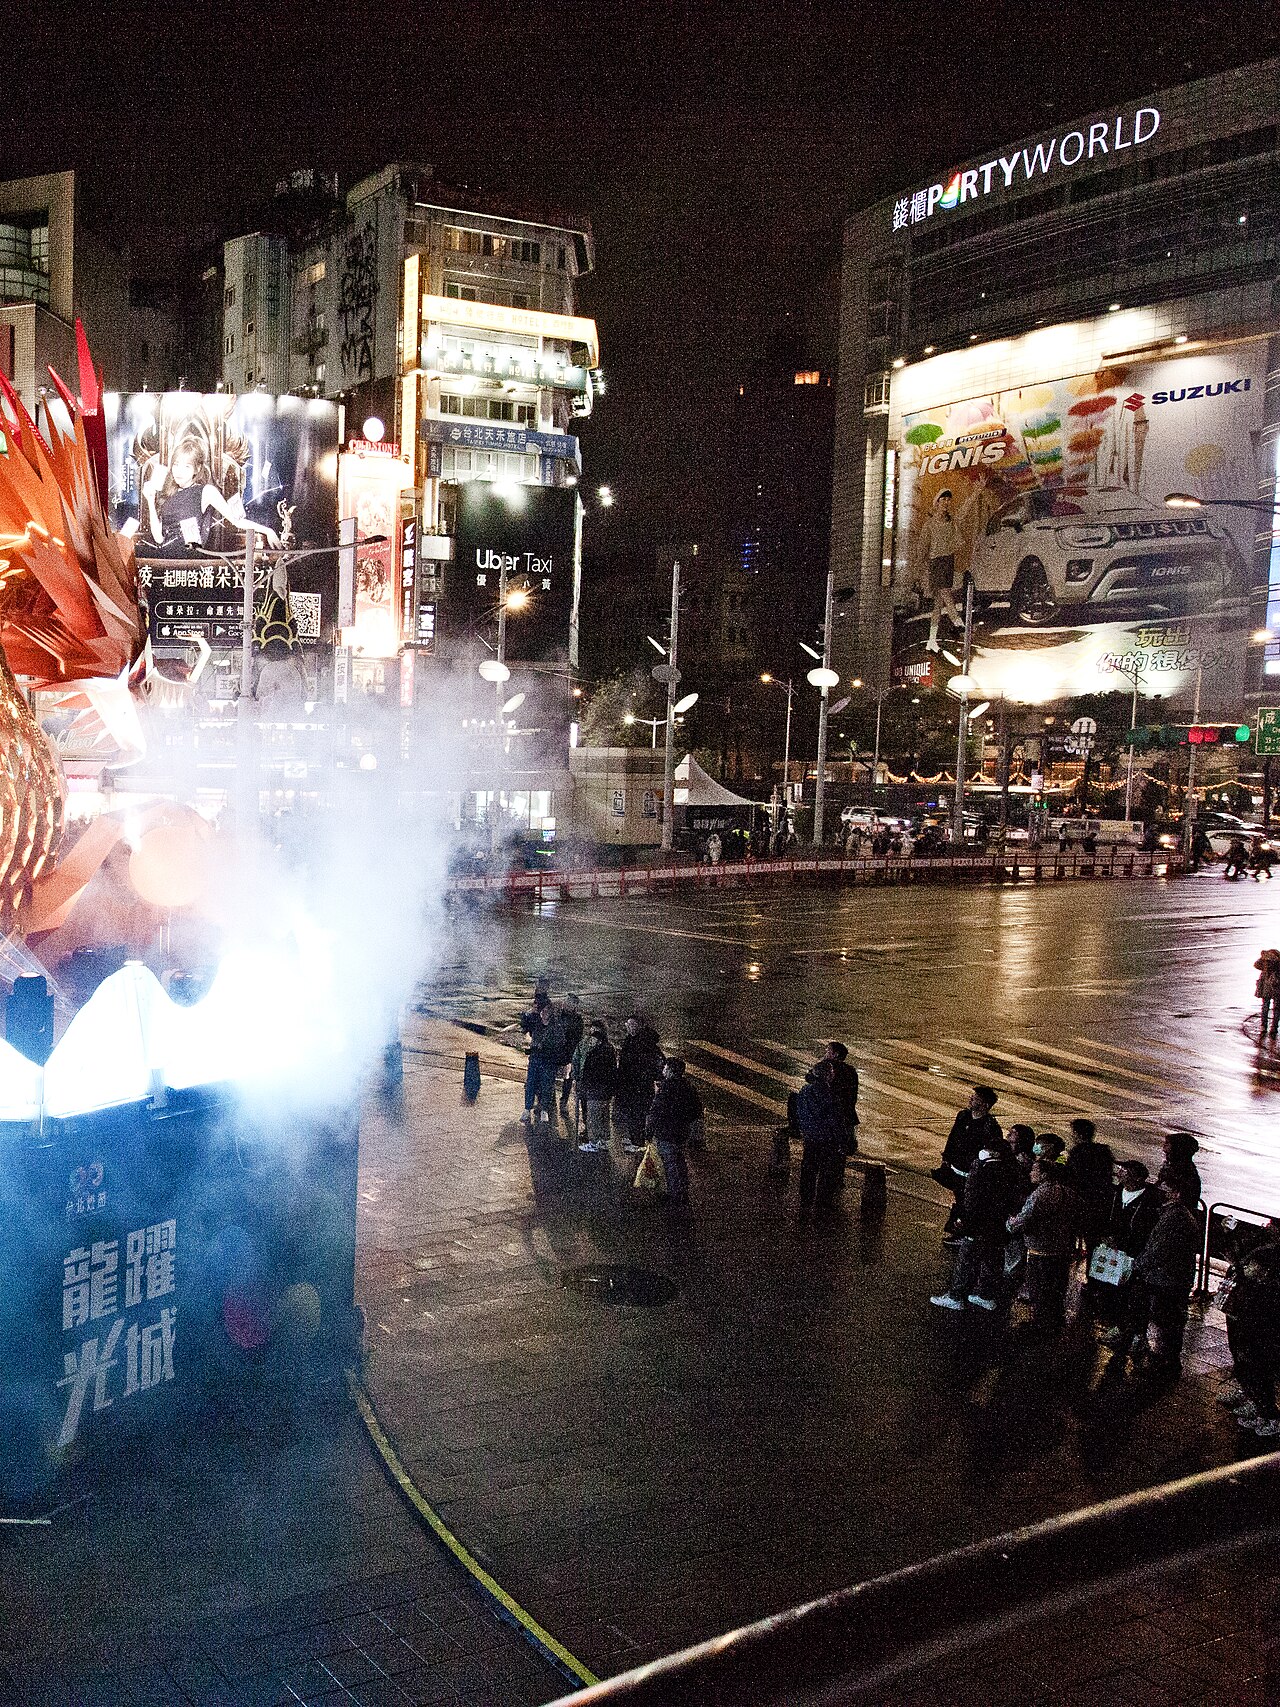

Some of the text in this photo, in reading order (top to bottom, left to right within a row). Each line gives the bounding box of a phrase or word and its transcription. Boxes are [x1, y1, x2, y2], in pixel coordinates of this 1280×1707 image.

[892, 189, 927, 232] 錢櫃
[1151, 378, 1251, 405] SUZUKI
[918, 441, 1007, 477] IGNIS
[476, 549, 553, 573] Uber Taxi
[904, 661, 931, 677] UNIQUE
[63, 1218, 177, 1331] 龍躍
[56, 1305, 177, 1448] 光城
